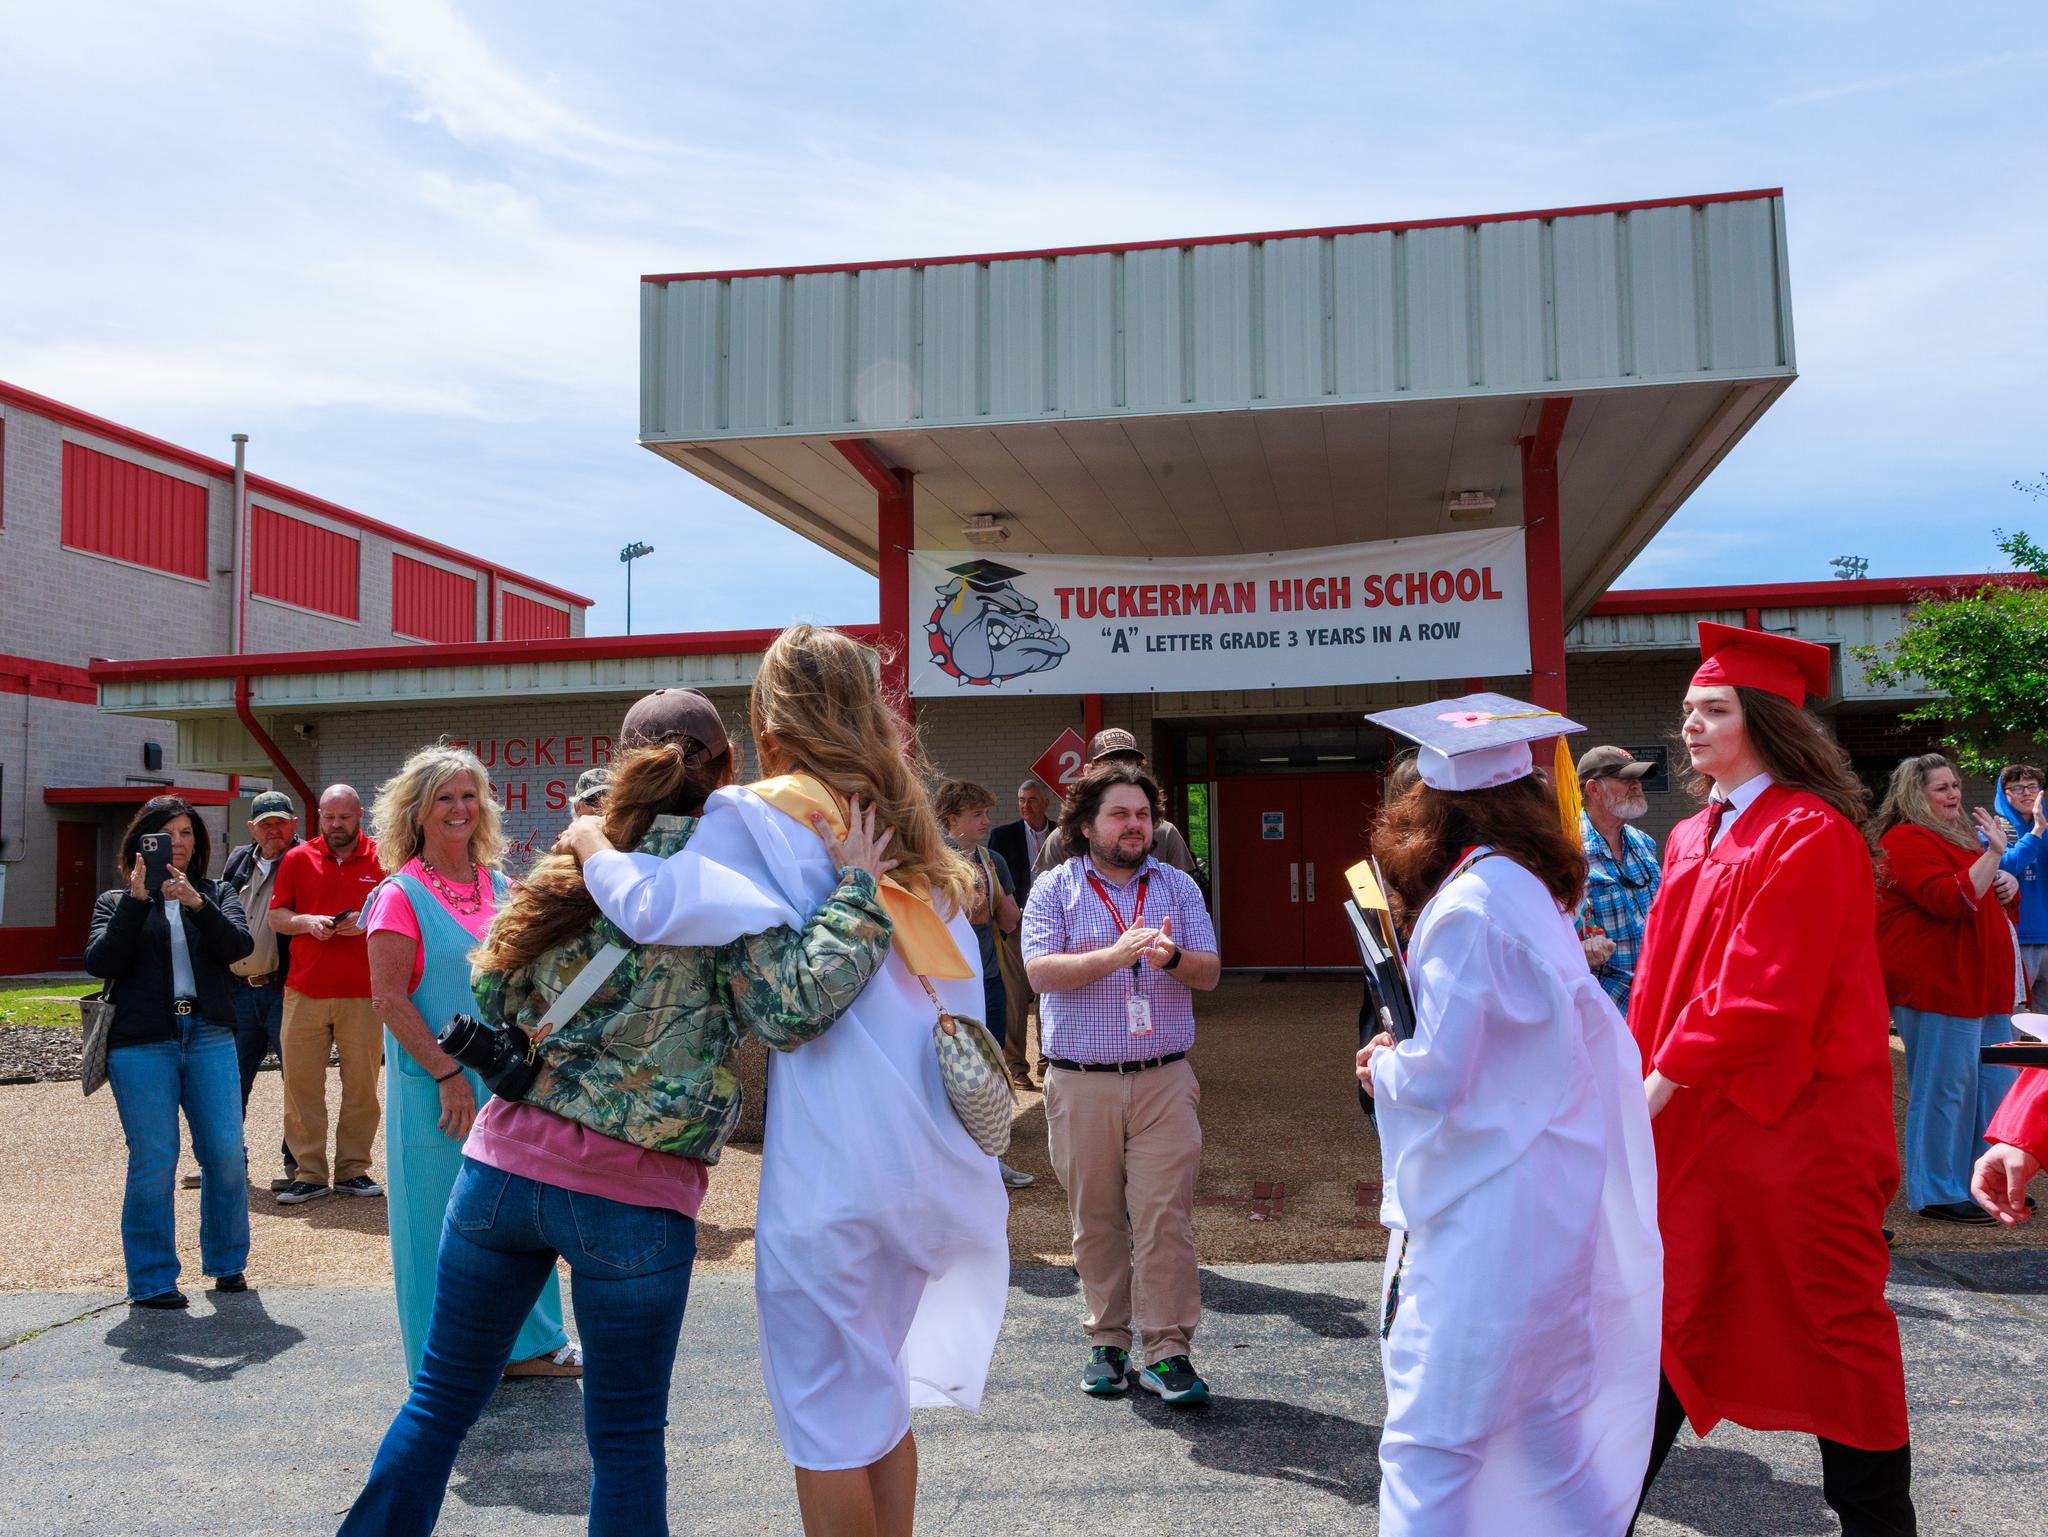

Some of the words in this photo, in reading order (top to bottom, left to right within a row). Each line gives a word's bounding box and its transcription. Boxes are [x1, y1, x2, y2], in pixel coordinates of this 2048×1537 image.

[1054, 581, 1256, 619] TUCKERMAN
[1269, 576, 1352, 612] HIGH
[1363, 567, 1503, 608] SCHOOL
[1146, 633, 1213, 652] LETTER
[1219, 631, 1280, 650] GRADE
[1287, 631, 1299, 647] 3
[1306, 626, 1366, 646] YEARS
[1373, 626, 1392, 643] IN
[1398, 624, 1412, 642] A
[1418, 621, 1461, 641] ROW
[1059, 750, 1081, 784] 2
